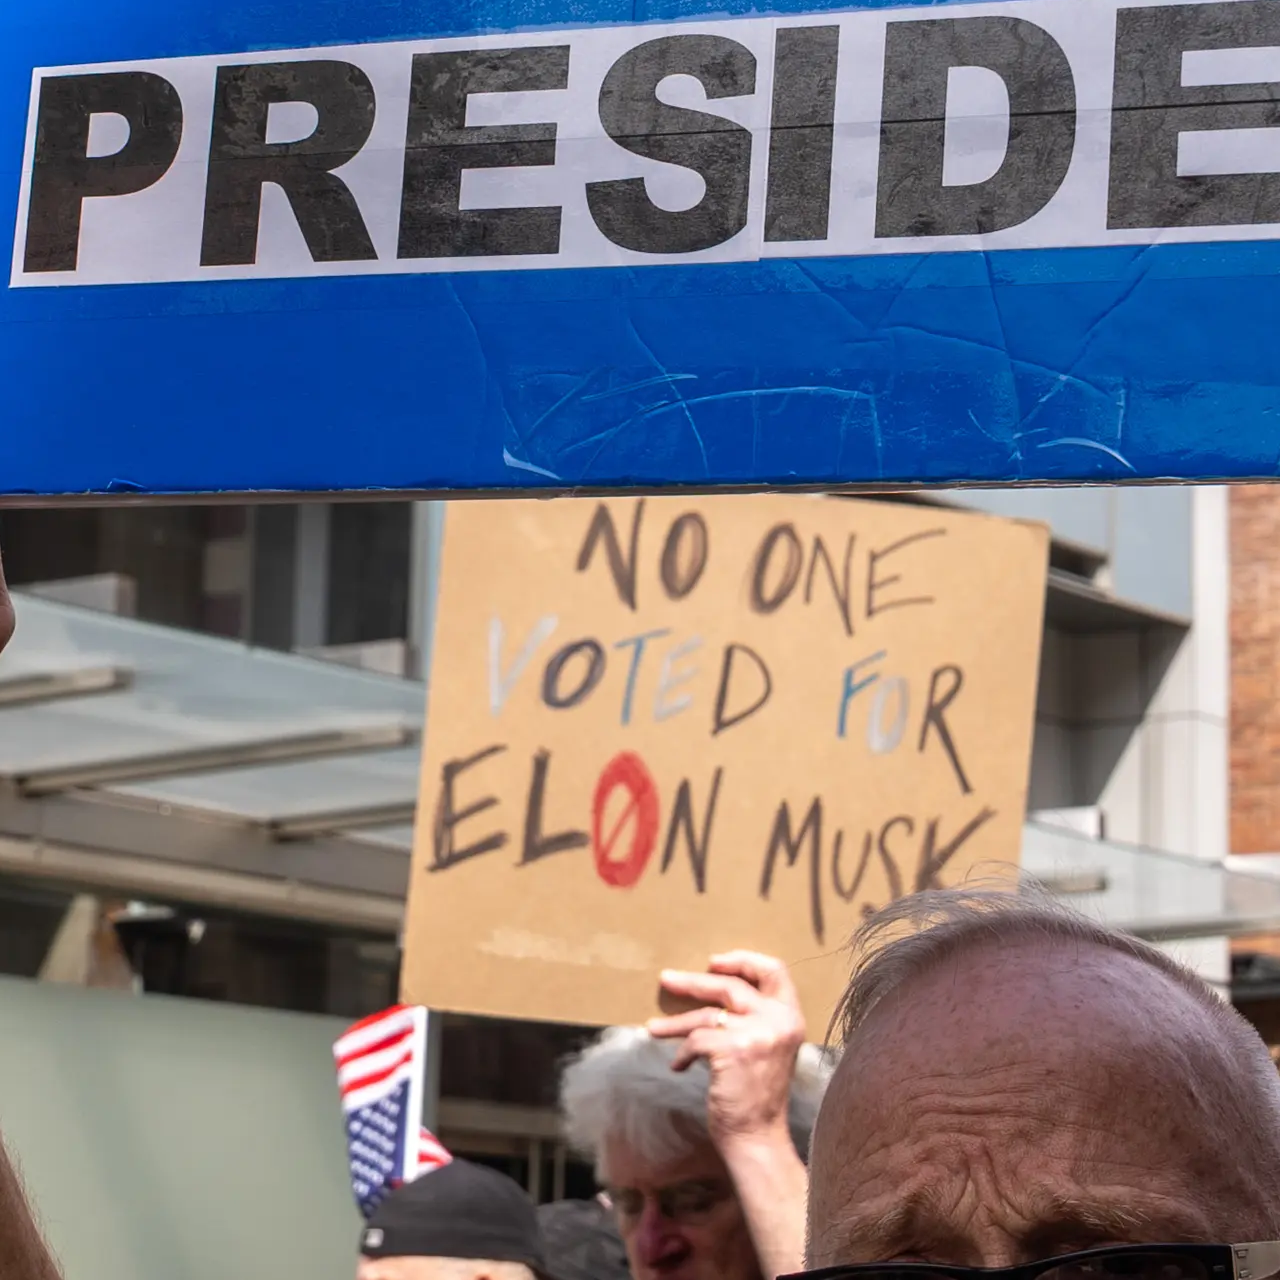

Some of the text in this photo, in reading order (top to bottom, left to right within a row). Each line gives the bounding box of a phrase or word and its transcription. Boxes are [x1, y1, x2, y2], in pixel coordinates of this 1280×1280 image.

[577, 497, 947, 636] NO ONE
[488, 613, 973, 794] VOTED FOR
[426, 743, 998, 947] ELON MUSK
